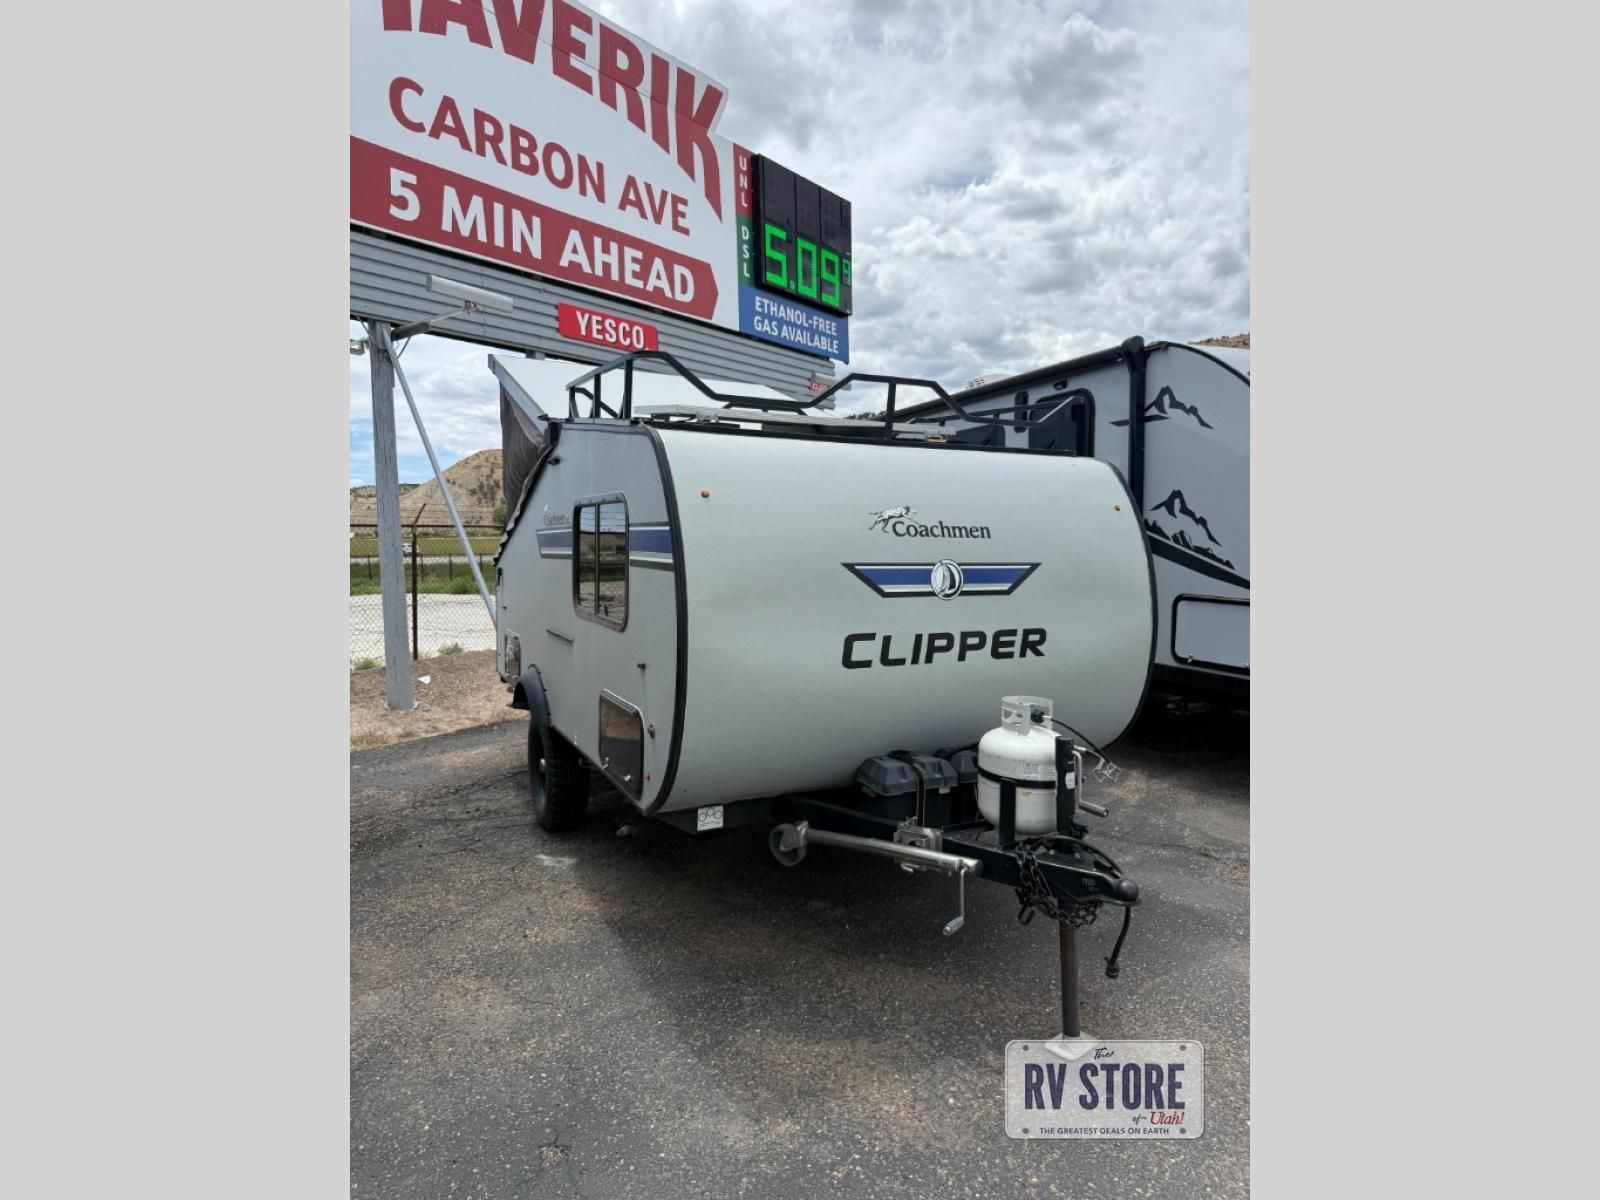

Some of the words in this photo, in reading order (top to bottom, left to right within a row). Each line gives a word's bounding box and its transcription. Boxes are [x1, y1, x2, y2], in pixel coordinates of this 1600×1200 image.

[382, 0, 724, 223] AVERIK
[390, 76, 605, 204] CARBON
[618, 174, 690, 236] AVE
[739, 155, 748, 208] UNL
[389, 167, 420, 221] 5
[441, 184, 541, 260] MIN
[559, 228, 695, 303] AHEAD
[741, 226, 750, 278] DSL
[753, 315, 778, 336] GAS
[781, 324, 839, 354] AVAILABLE
[754, 295, 837, 336] ETHANOL-FREE
[892, 520, 991, 539] Coachmen
[841, 627, 1047, 669] CLIPPER
